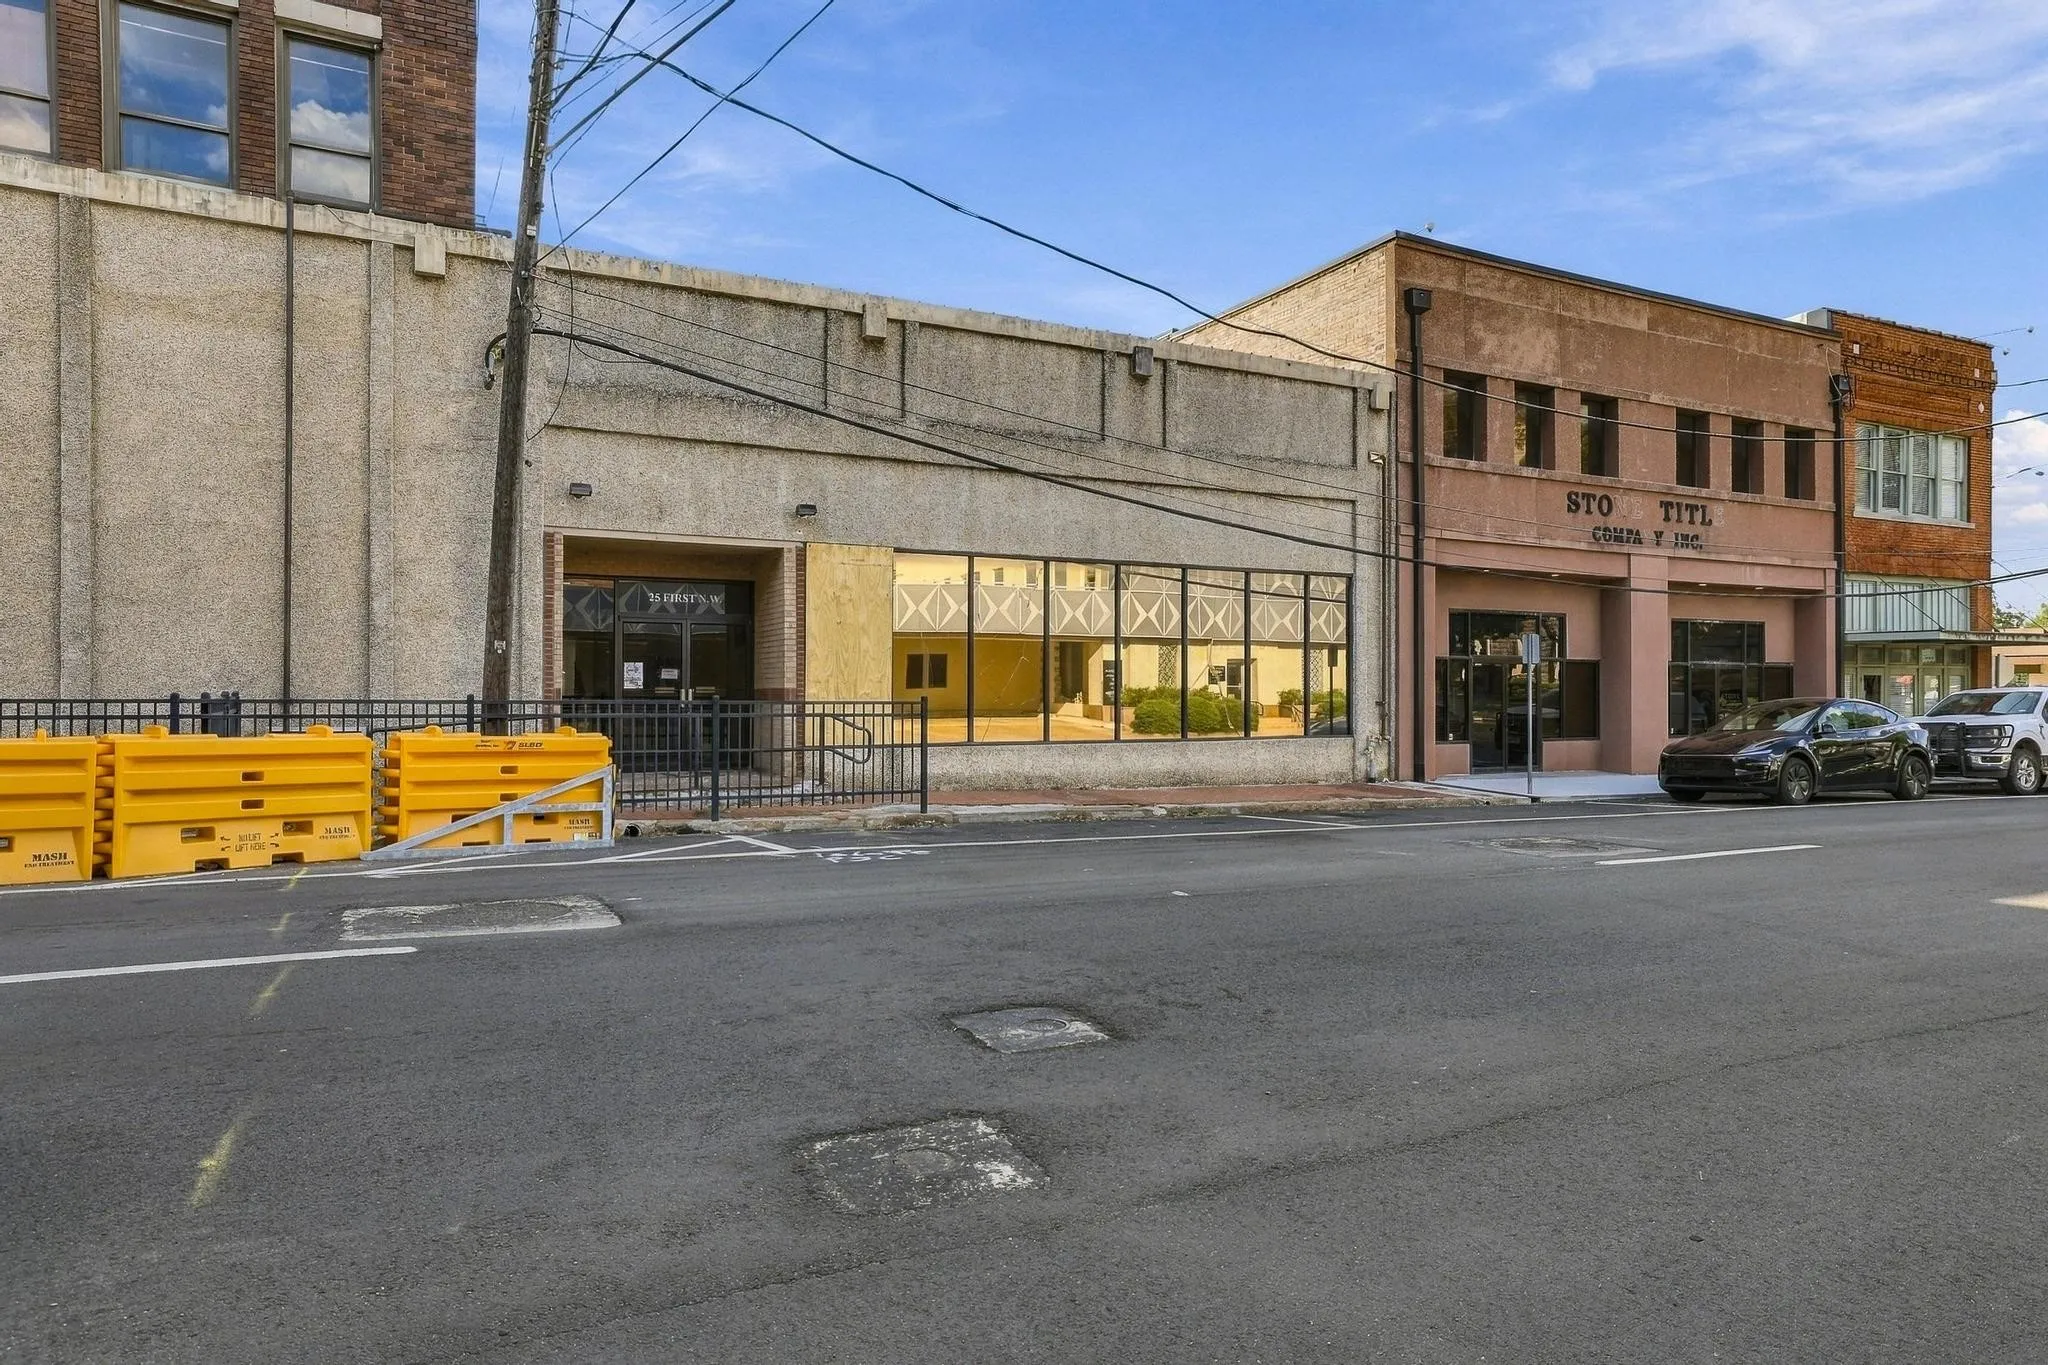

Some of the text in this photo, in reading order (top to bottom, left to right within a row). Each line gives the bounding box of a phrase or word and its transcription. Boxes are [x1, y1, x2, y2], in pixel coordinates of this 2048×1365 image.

[1567, 490, 1728, 528] STO TITL
[1592, 526, 1664, 546] COMPAY
[648, 592, 661, 602] 25
[663, 592, 697, 603] FIRST
[32, 852, 68, 862] MASH
